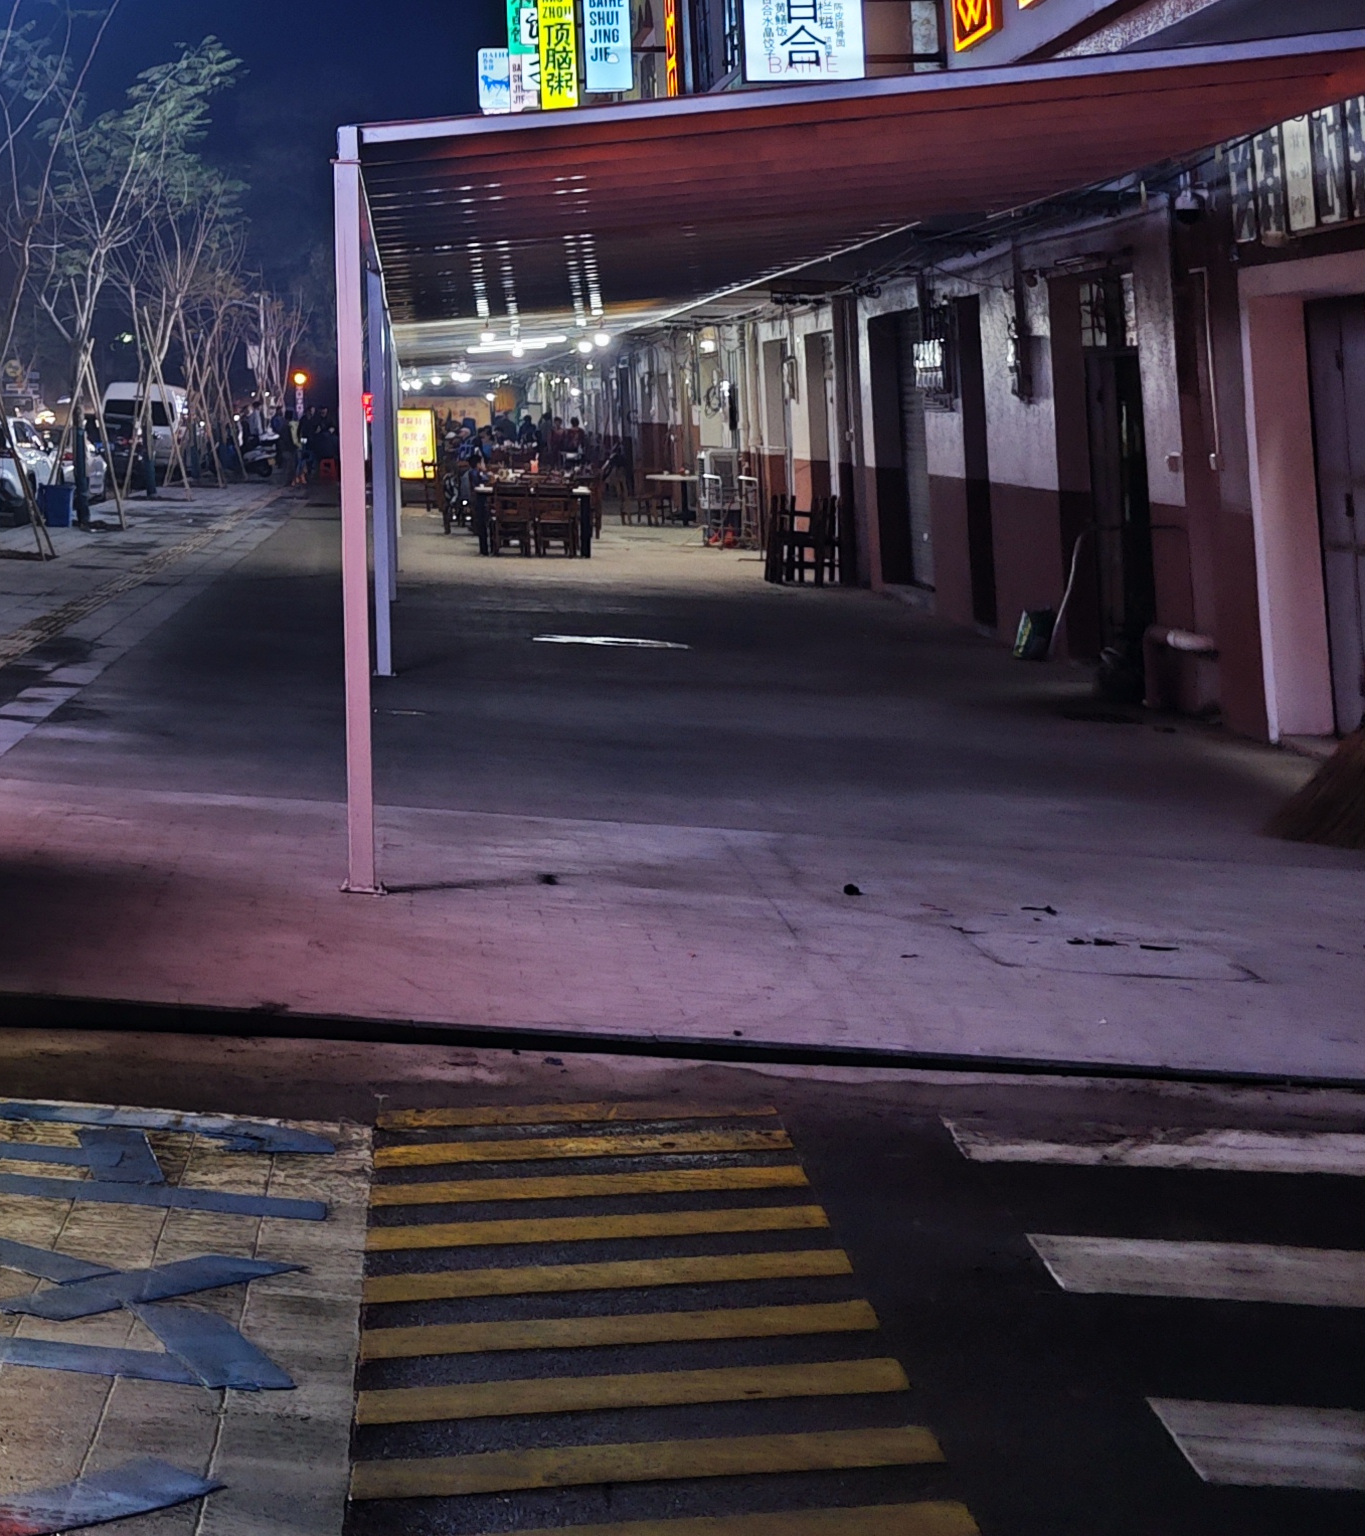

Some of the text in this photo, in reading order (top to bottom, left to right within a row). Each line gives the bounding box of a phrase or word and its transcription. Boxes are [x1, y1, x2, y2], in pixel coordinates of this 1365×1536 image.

[542, 6, 572, 19] ZHOU
[589, 10, 620, 26] SHUI
[589, 28, 620, 44] JING
[543, 22, 573, 96] 顶脑粥
[768, 55, 839, 74] BAIHE
